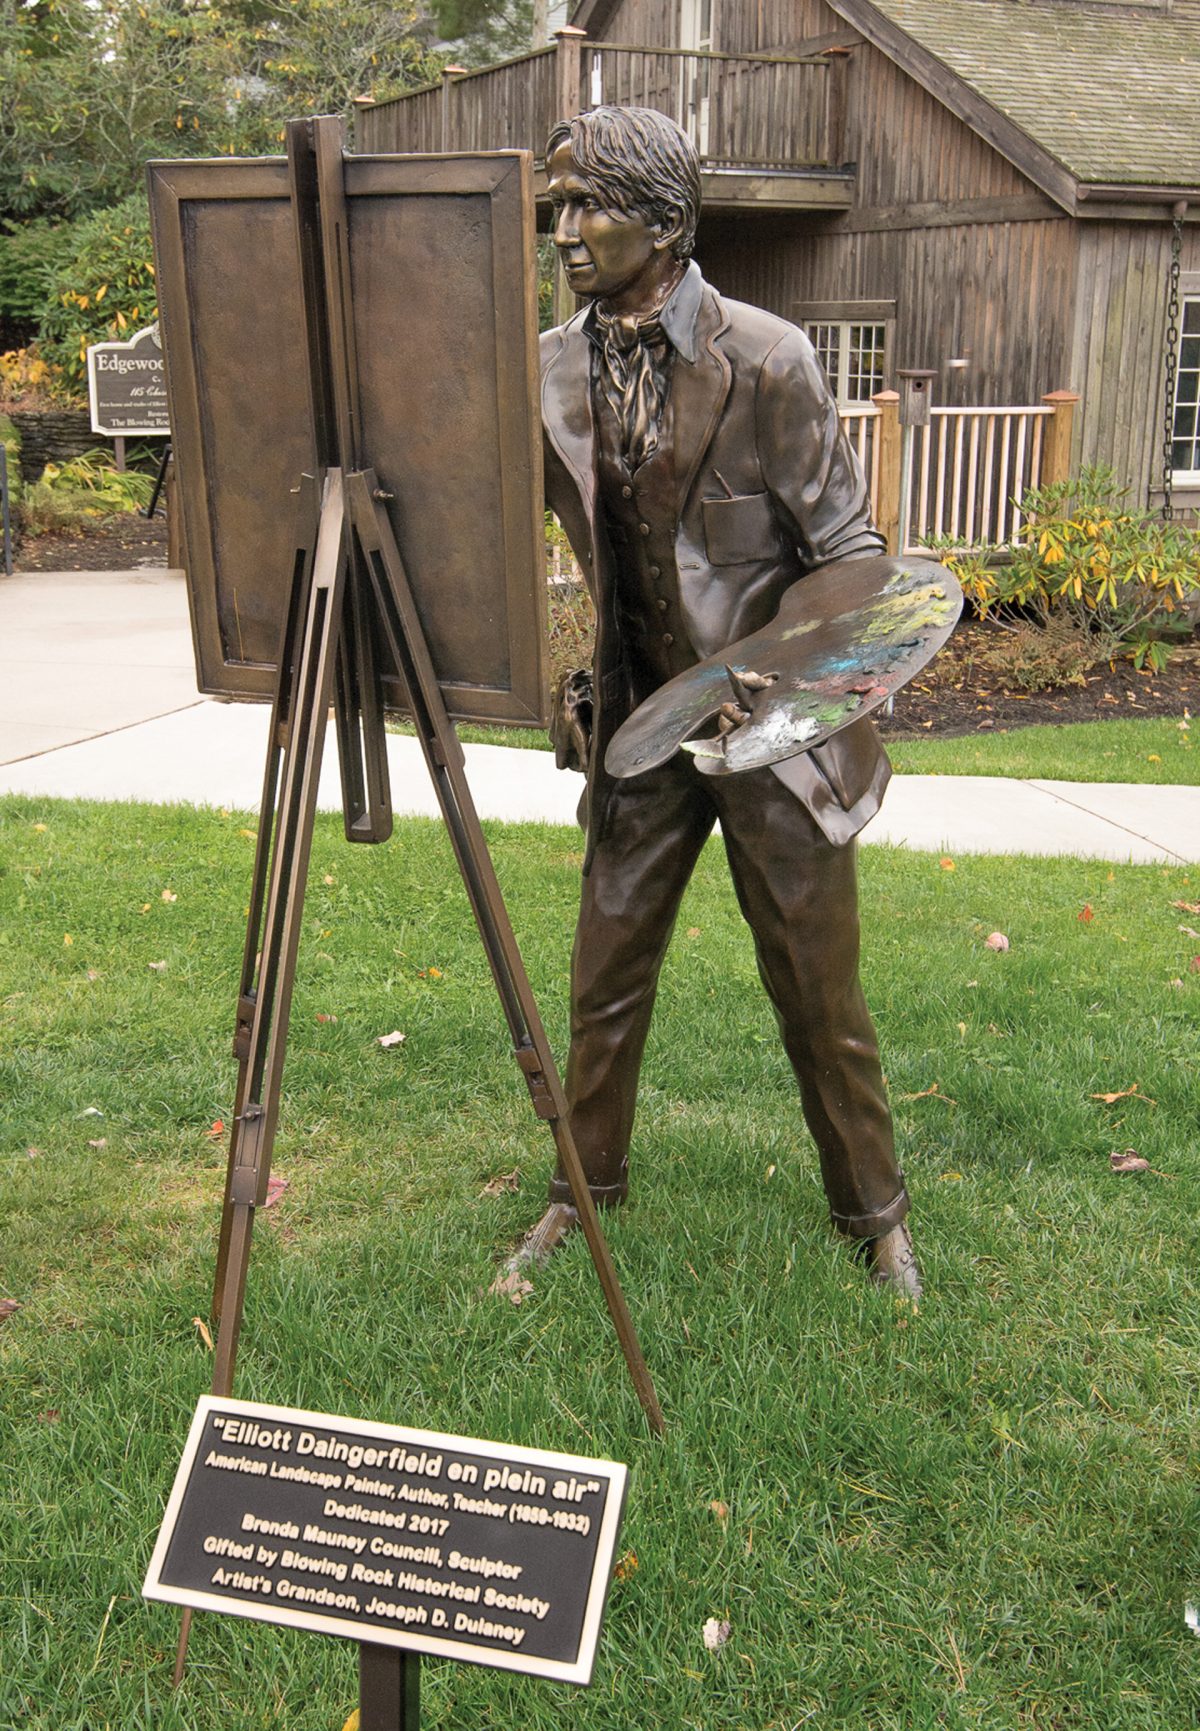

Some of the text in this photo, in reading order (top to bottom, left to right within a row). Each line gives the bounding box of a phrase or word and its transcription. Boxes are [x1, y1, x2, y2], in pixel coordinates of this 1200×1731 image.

[110, 418, 125, 426] The
[127, 418, 155, 427] Blowing
[205, 1450, 267, 1476] American
[269, 1461, 342, 1490] Landscape
[344, 1474, 396, 1500] Painter,
[397, 1484, 449, 1511] Author,
[453, 1492, 508, 1518] Teacher
[213, 1417, 293, 1452] "Elliott
[296, 1432, 443, 1478] Daingerfield
[483, 1466, 546, 1496] plein
[552, 1478, 600, 1503] air"
[241, 1513, 300, 1539] Brenda
[303, 1525, 367, 1555] Mauney
[448, 1551, 523, 1580] Sculptor
[323, 1499, 450, 1536] Dedicated 2017
[203, 1536, 550, 1619] Gifted by Blowing Rock Historical Society
[211, 1567, 526, 1646] Artist's Grandson, Joseph D. Dulaney
